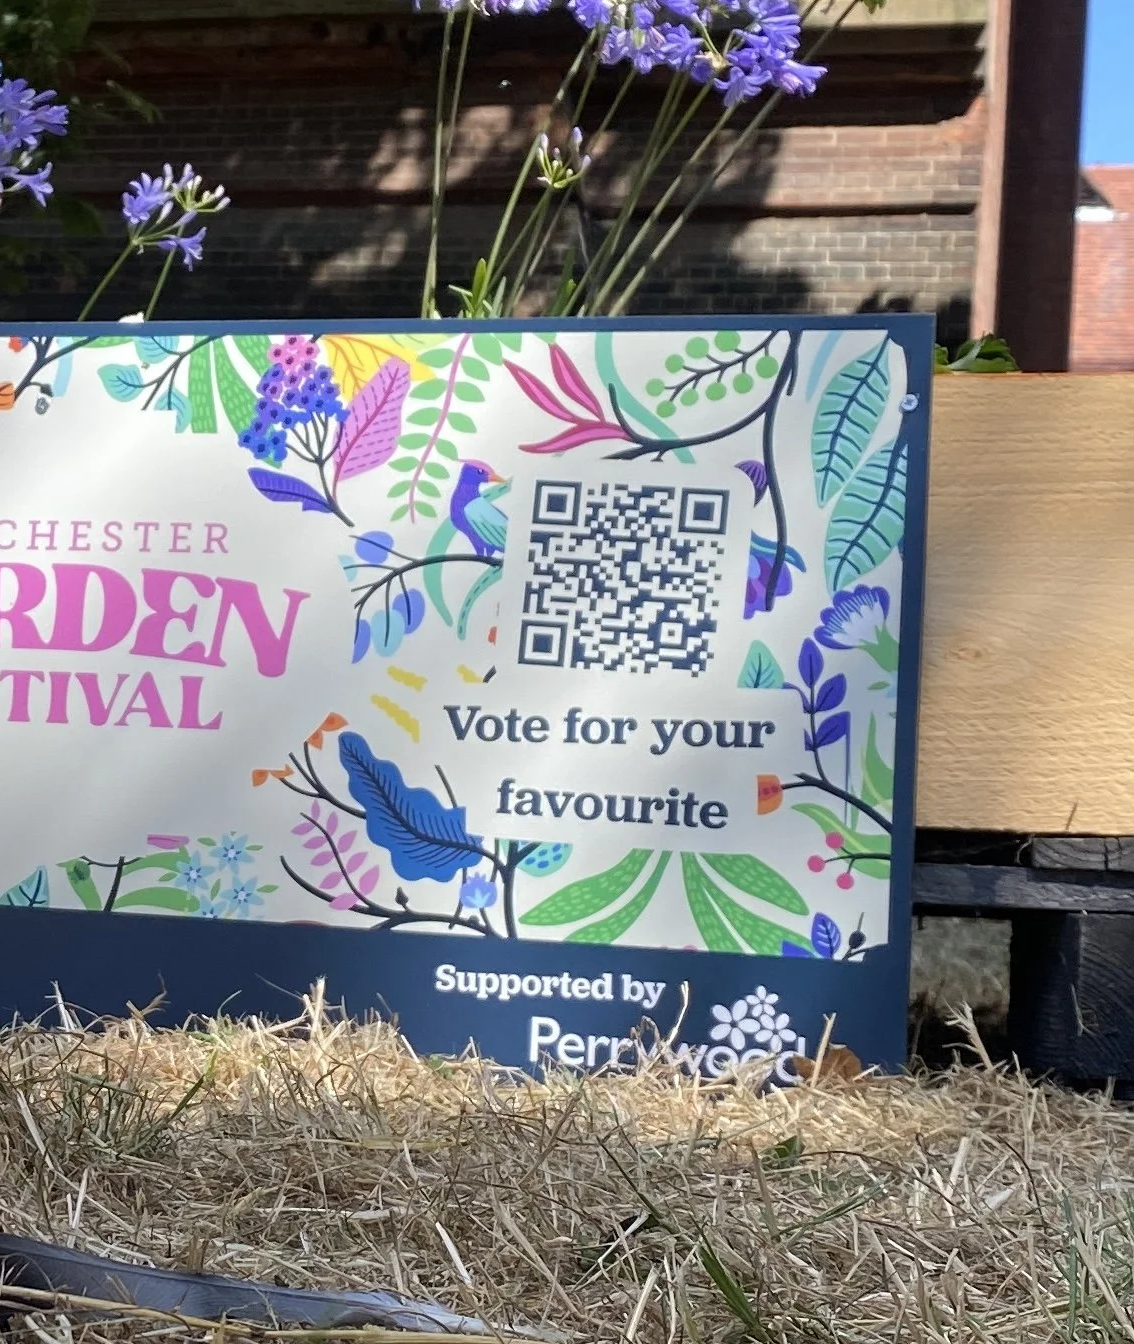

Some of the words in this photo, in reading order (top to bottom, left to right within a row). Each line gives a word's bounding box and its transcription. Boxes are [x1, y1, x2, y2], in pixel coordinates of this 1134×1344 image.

[443, 704, 550, 744] Vote
[563, 706, 637, 745] for
[650, 717, 776, 756] your
[495, 777, 729, 830] favourite
[435, 963, 614, 1003] Supported
[621, 973, 666, 1009] by
